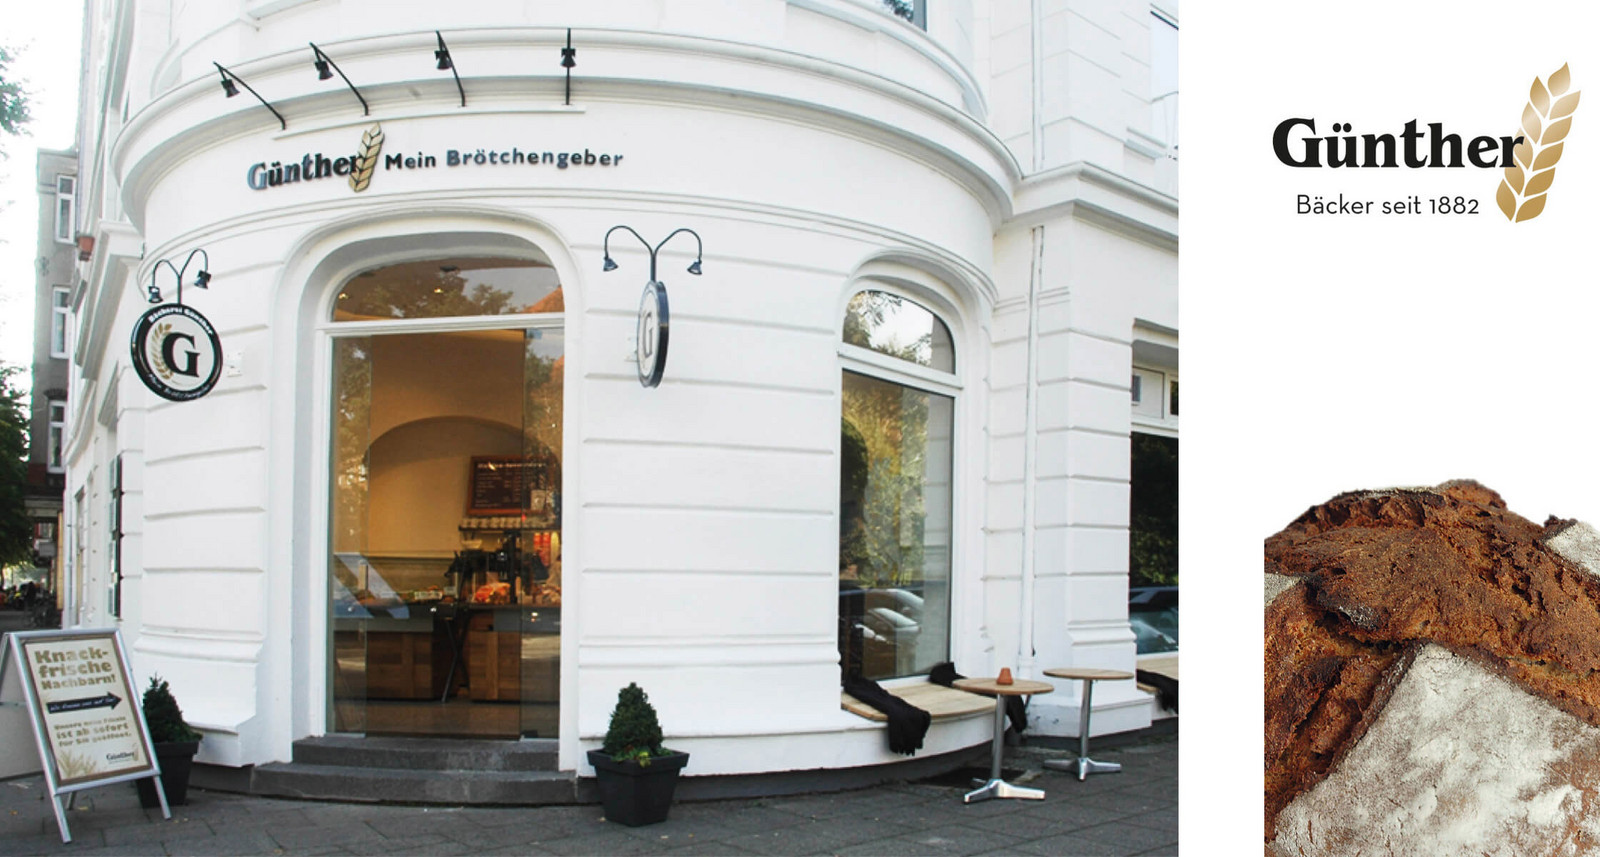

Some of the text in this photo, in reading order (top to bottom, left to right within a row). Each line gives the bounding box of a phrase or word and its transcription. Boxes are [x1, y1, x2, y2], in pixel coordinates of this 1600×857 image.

[246, 147, 624, 191] Günther Mein Brötchengeber
[161, 332, 201, 378] G
[35, 647, 108, 663] Knack-
[39, 660, 111, 677] frische
[42, 674, 116, 689] Nachbarn!
